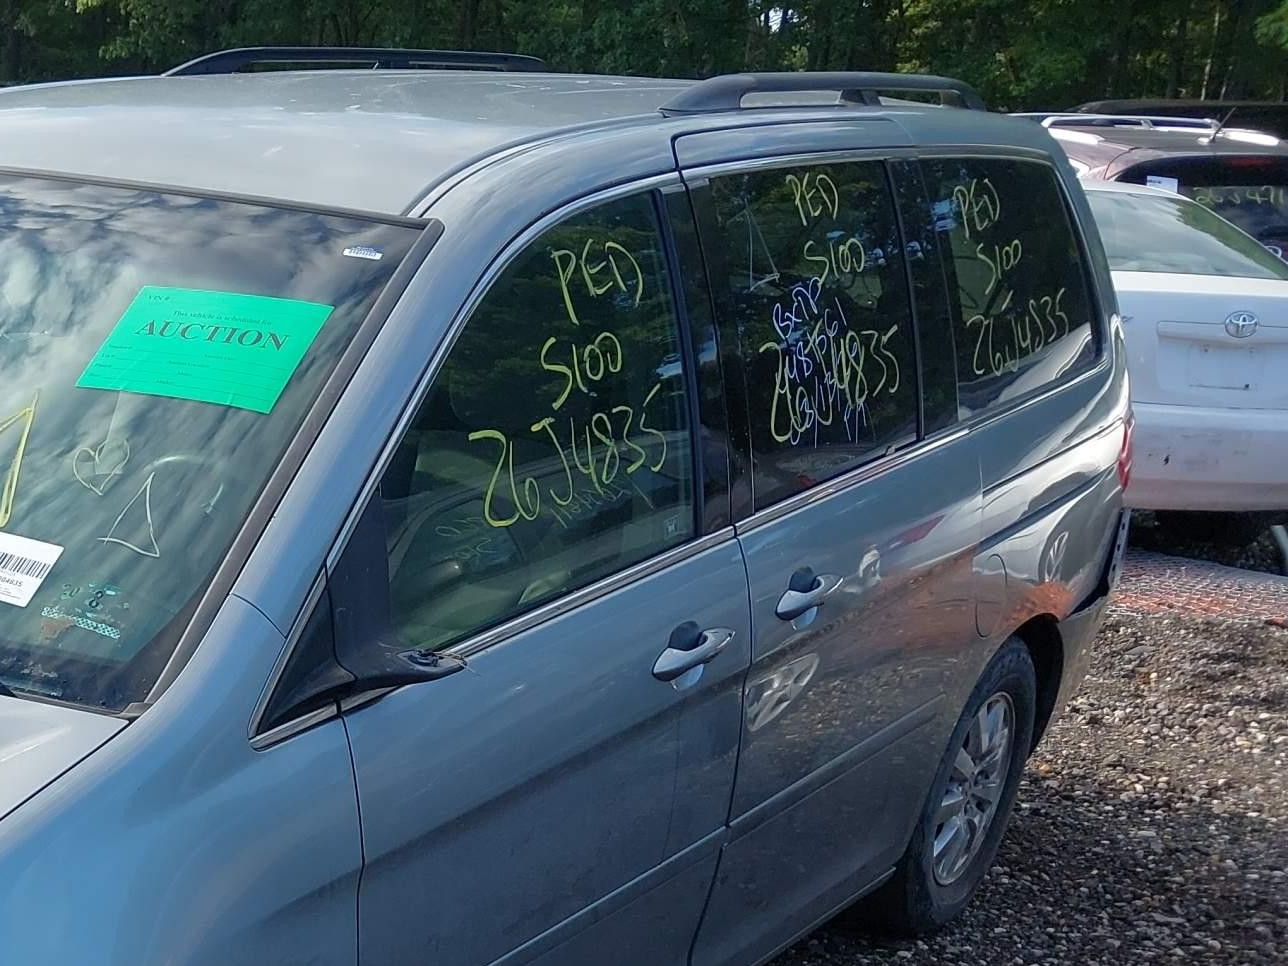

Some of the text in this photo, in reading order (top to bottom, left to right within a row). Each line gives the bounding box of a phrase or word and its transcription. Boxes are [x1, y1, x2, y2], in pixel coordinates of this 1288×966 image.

[785, 173, 841, 228] PED
[952, 178, 1001, 241] PED
[550, 237, 645, 325] PED
[803, 236, 866, 286] S100
[976, 238, 1023, 296] S100
[135, 319, 291, 351] AUCTION
[965, 288, 1070, 378] 26J4835
[539, 330, 624, 411] S100
[467, 382, 669, 529] 26J4835
